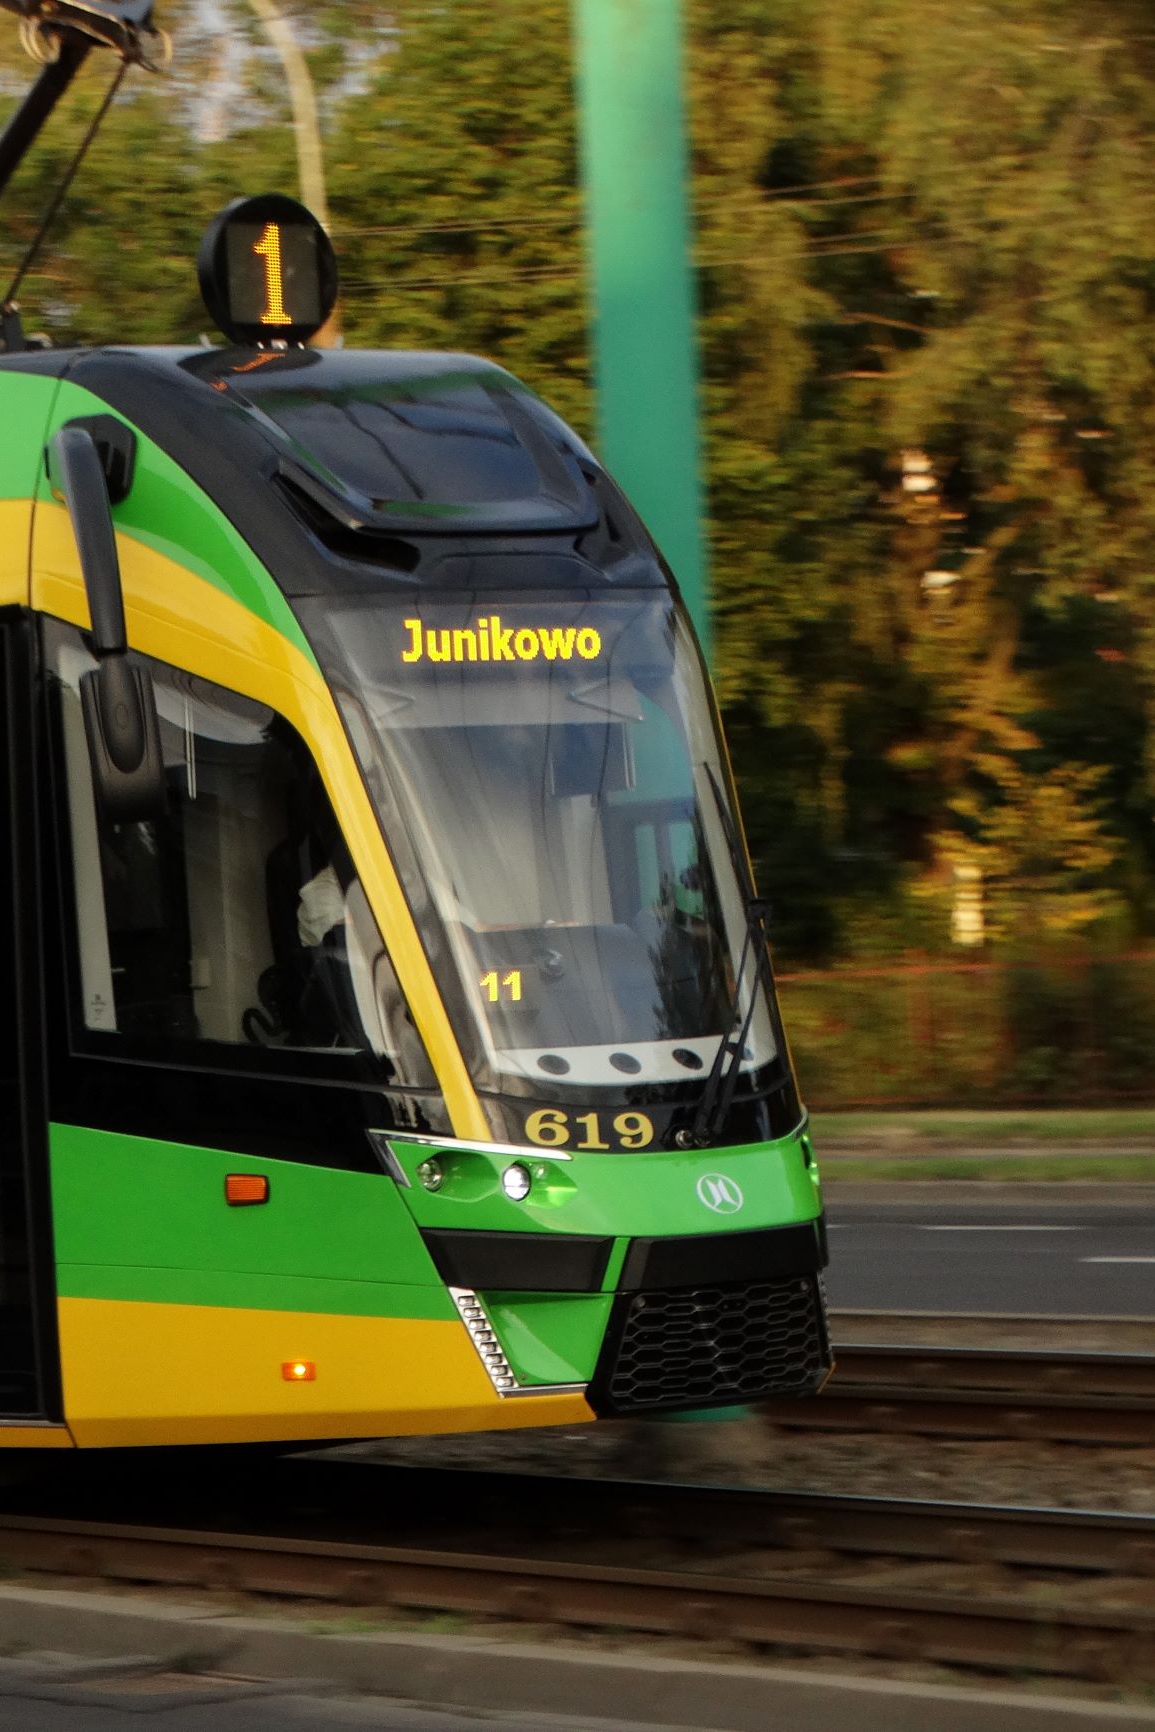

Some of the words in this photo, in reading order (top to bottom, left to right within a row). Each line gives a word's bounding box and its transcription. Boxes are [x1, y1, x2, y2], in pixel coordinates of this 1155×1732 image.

[253, 222, 292, 324] 1
[402, 616, 602, 662] Junikowo
[480, 971, 522, 1002] 11
[524, 1108, 655, 1151] 619
